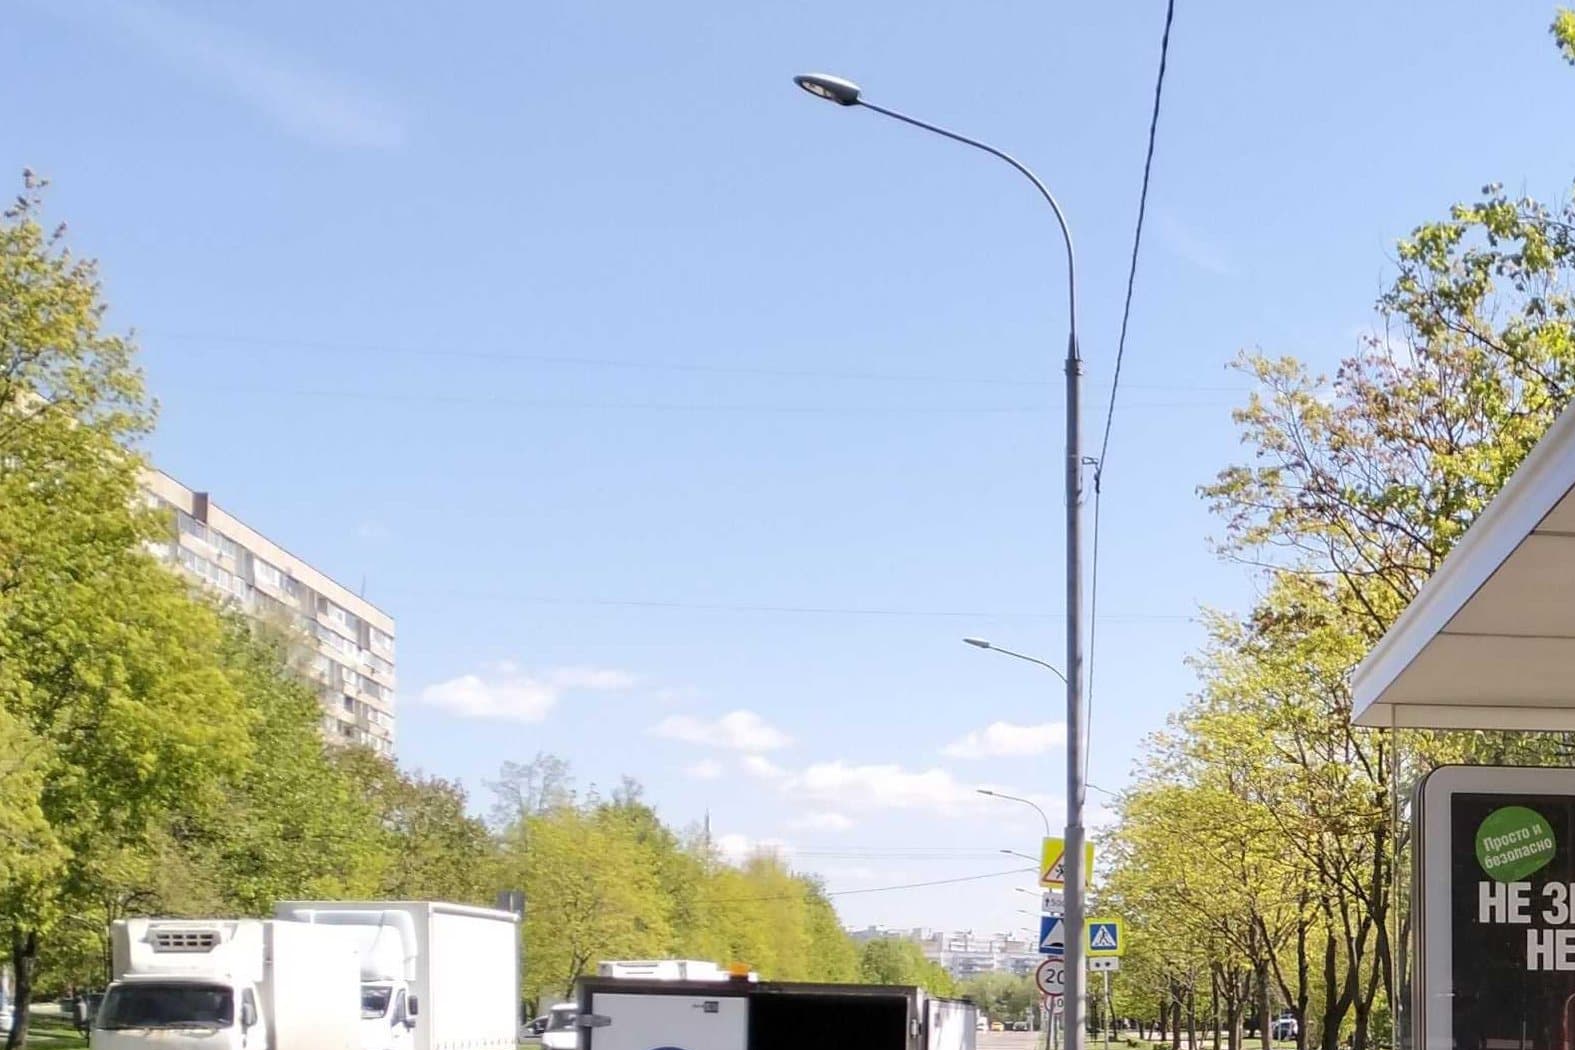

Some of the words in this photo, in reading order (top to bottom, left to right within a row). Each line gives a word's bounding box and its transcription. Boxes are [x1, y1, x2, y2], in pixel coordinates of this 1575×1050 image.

[1482, 827, 1530, 852] Просто
[1532, 823, 1542, 836] и
[1484, 838, 1552, 869] безопасно
[1478, 881, 1532, 924] НЕ
